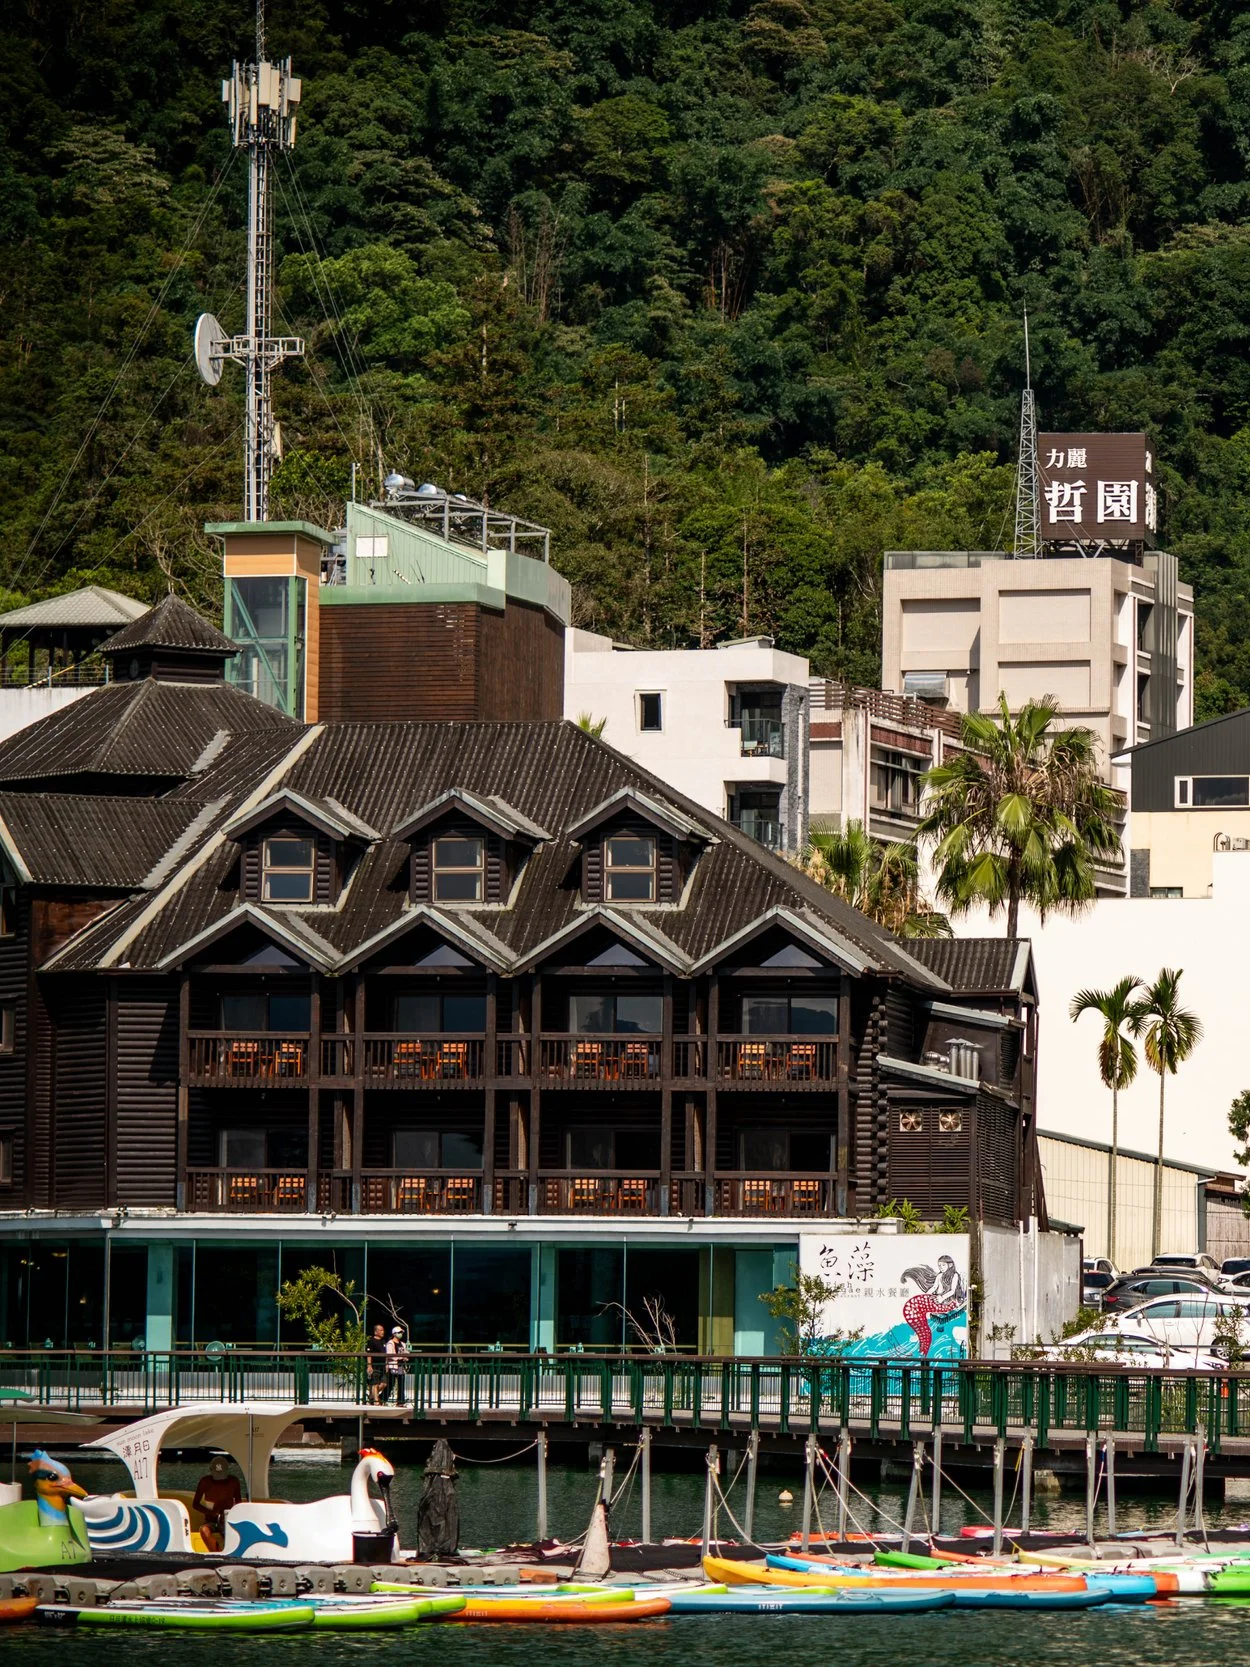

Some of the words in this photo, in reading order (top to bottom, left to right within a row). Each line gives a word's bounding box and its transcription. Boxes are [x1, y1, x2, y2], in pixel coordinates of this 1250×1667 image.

[1045, 448, 1087, 469] 力麗
[1044, 480, 1139, 524] 哲園
[819, 1242, 875, 1282] 魚藻
[864, 1287, 910, 1298] 親水餐廳
